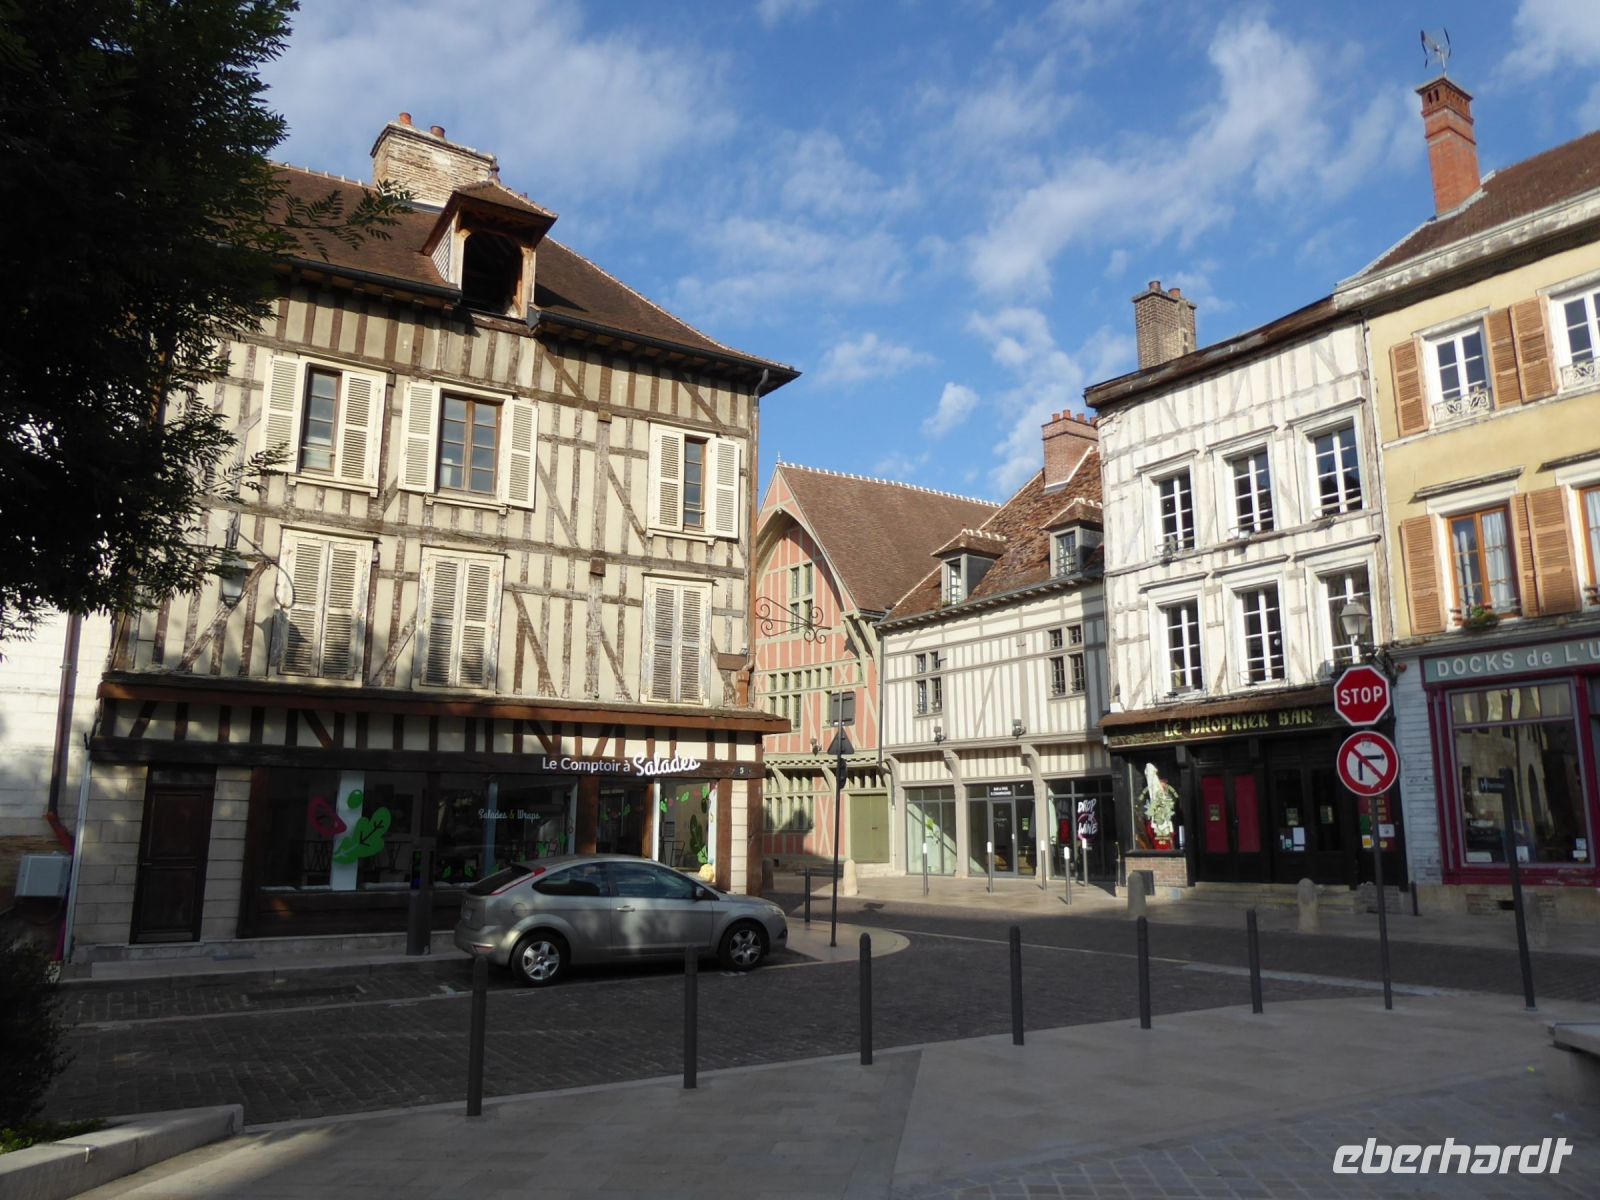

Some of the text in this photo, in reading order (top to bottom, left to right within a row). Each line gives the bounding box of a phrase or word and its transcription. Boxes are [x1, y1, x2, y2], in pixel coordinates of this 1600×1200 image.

[1436, 651, 1515, 677] DOCKS
[1526, 648, 1554, 667] de
[1340, 685, 1383, 706] STOP
[1164, 721, 1183, 737] LE
[1278, 709, 1313, 727] BAR
[542, 750, 701, 777] Le Comptoir à Salades
[478, 808, 508, 820] Salades
[516, 808, 541, 824] Wraps
[1077, 798, 1097, 813] DROP
